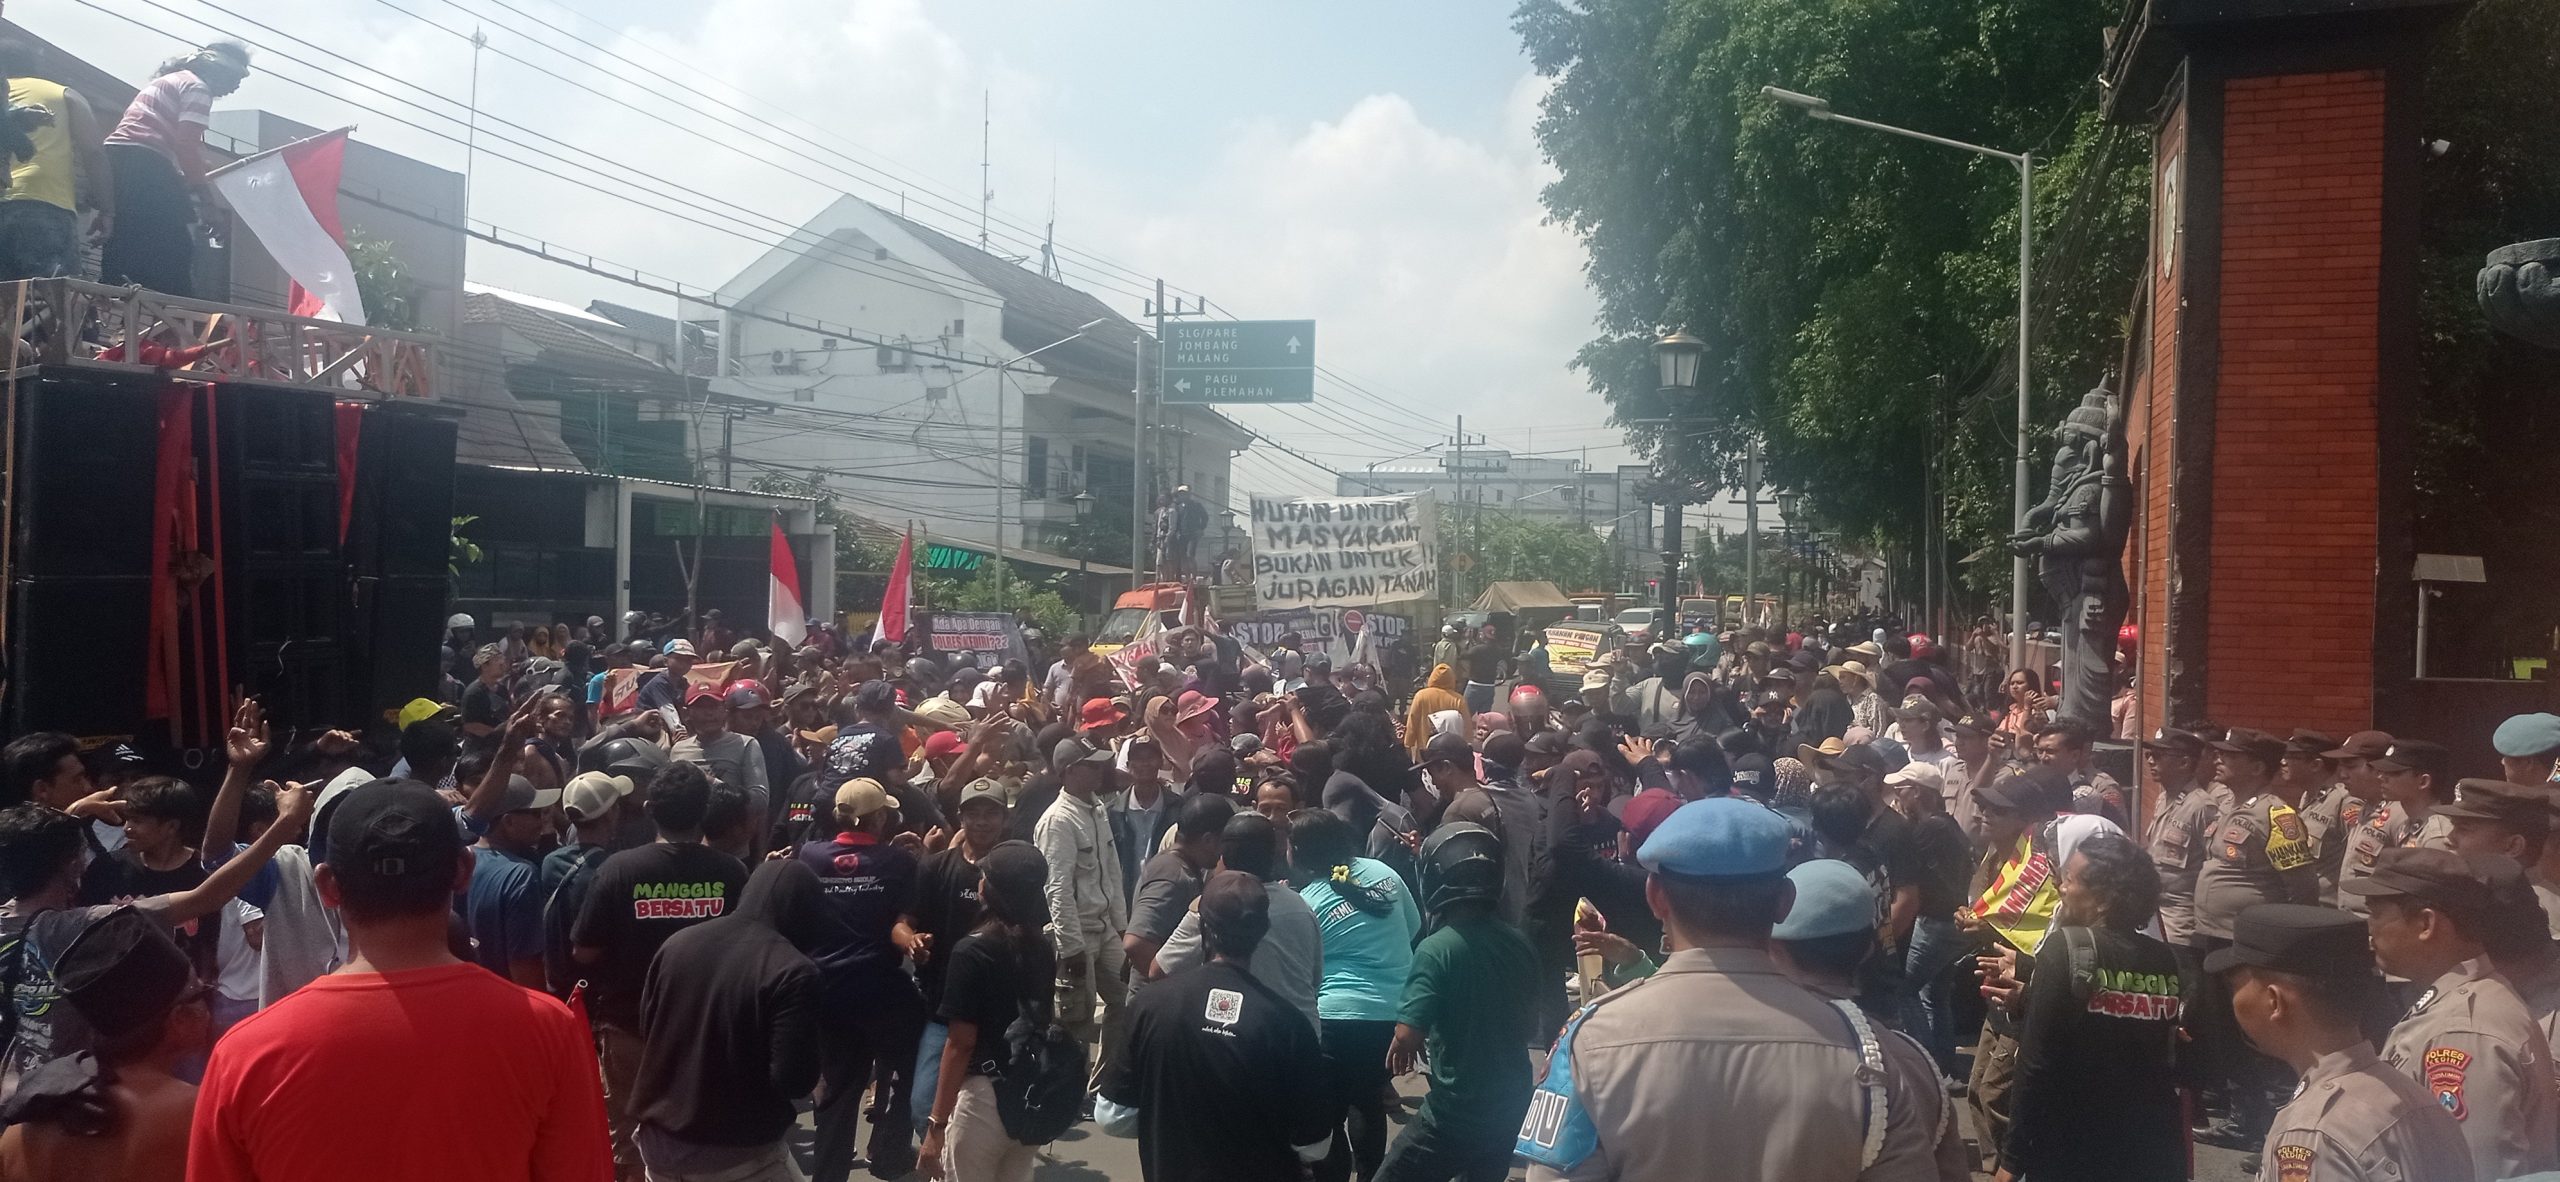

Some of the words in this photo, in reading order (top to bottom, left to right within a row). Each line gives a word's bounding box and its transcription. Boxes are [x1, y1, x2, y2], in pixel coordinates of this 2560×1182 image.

[1178, 328, 1238, 339] SLG/PARE
[1178, 340, 1238, 351] JOMBANG
[1177, 353, 1230, 363] MALANG
[1205, 375, 1238, 384] PAGU
[1204, 387, 1273, 397] PLEMAHAN
[1252, 499, 1330, 522] HUTAN
[1340, 502, 1411, 522] UNTUK
[1266, 524, 1421, 551] MASYARAKAT
[1255, 552, 1332, 575] BUKAN
[1340, 550, 1417, 571] UNTUK
[1379, 569, 1436, 594] TANAH
[1367, 613, 1405, 636] STOP
[1236, 622, 1285, 645] STOP
[633, 882, 725, 898] MANGGIS
[635, 897, 724, 919] BERSATU
[2426, 1049, 2465, 1063] POLRES
[2278, 1146, 2312, 1157] POLRES
